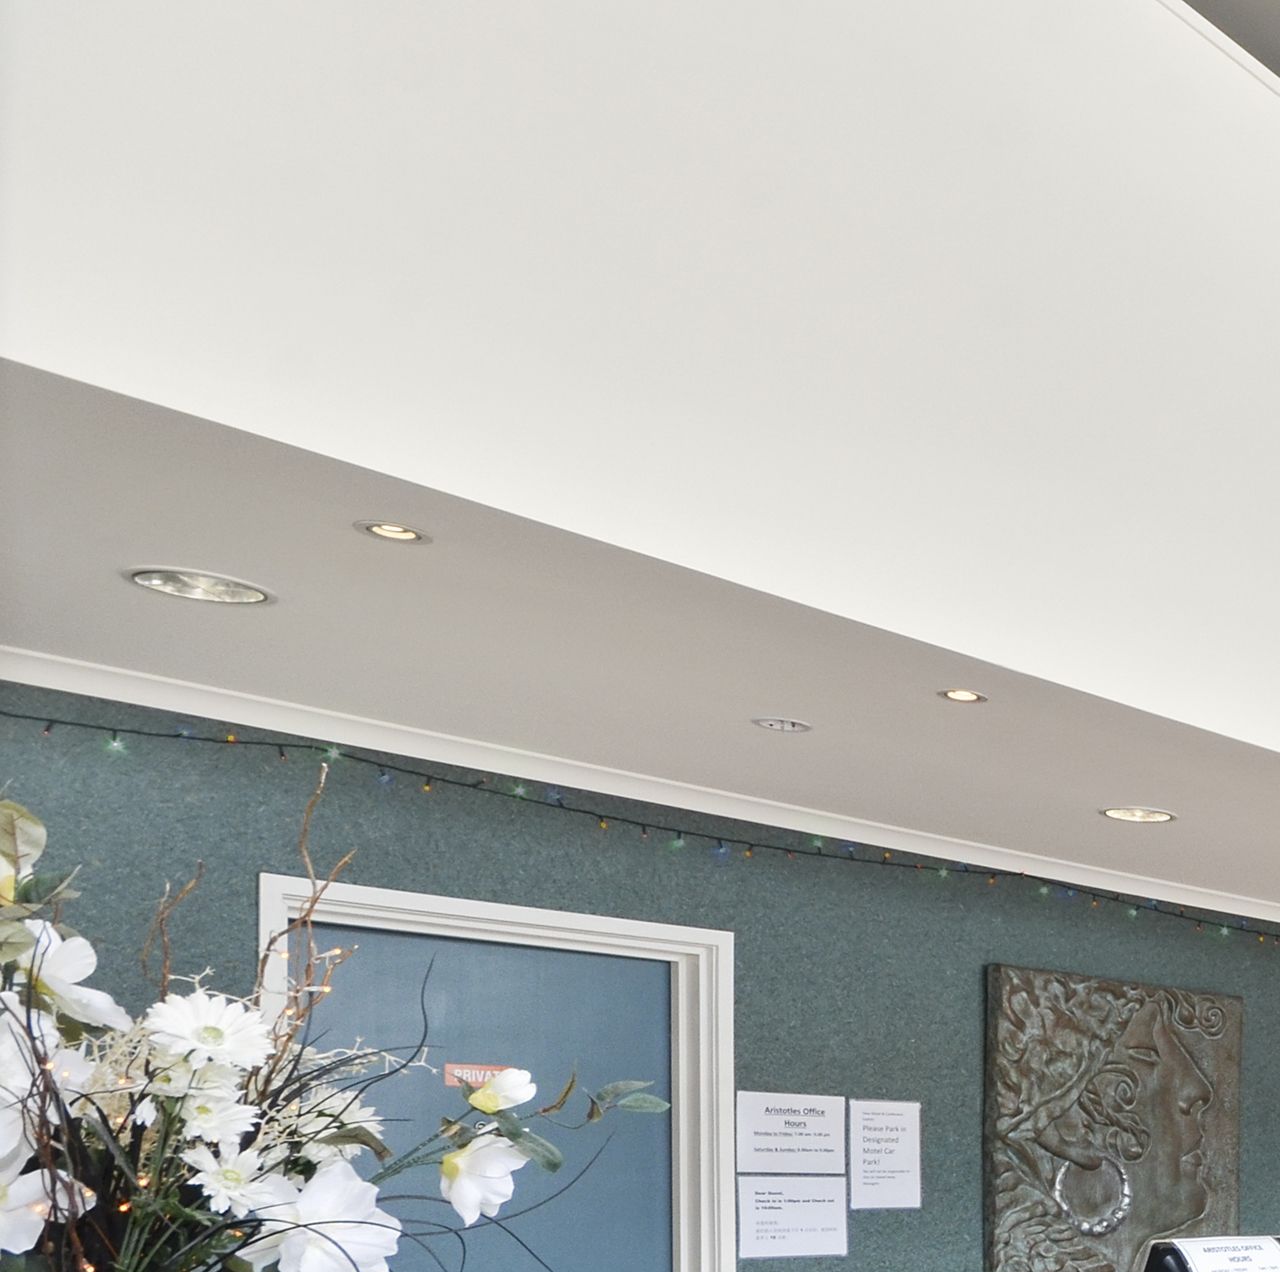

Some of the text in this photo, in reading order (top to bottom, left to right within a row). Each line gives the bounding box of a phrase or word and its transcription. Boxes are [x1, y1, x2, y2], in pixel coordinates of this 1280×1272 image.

[453, 1068, 501, 1083] PRIVAT
[764, 1106, 826, 1117] Aristotles Office
[784, 1120, 807, 1128] Hours
[862, 1136, 900, 1145] Designated
[862, 1147, 896, 1155] Motel Car
